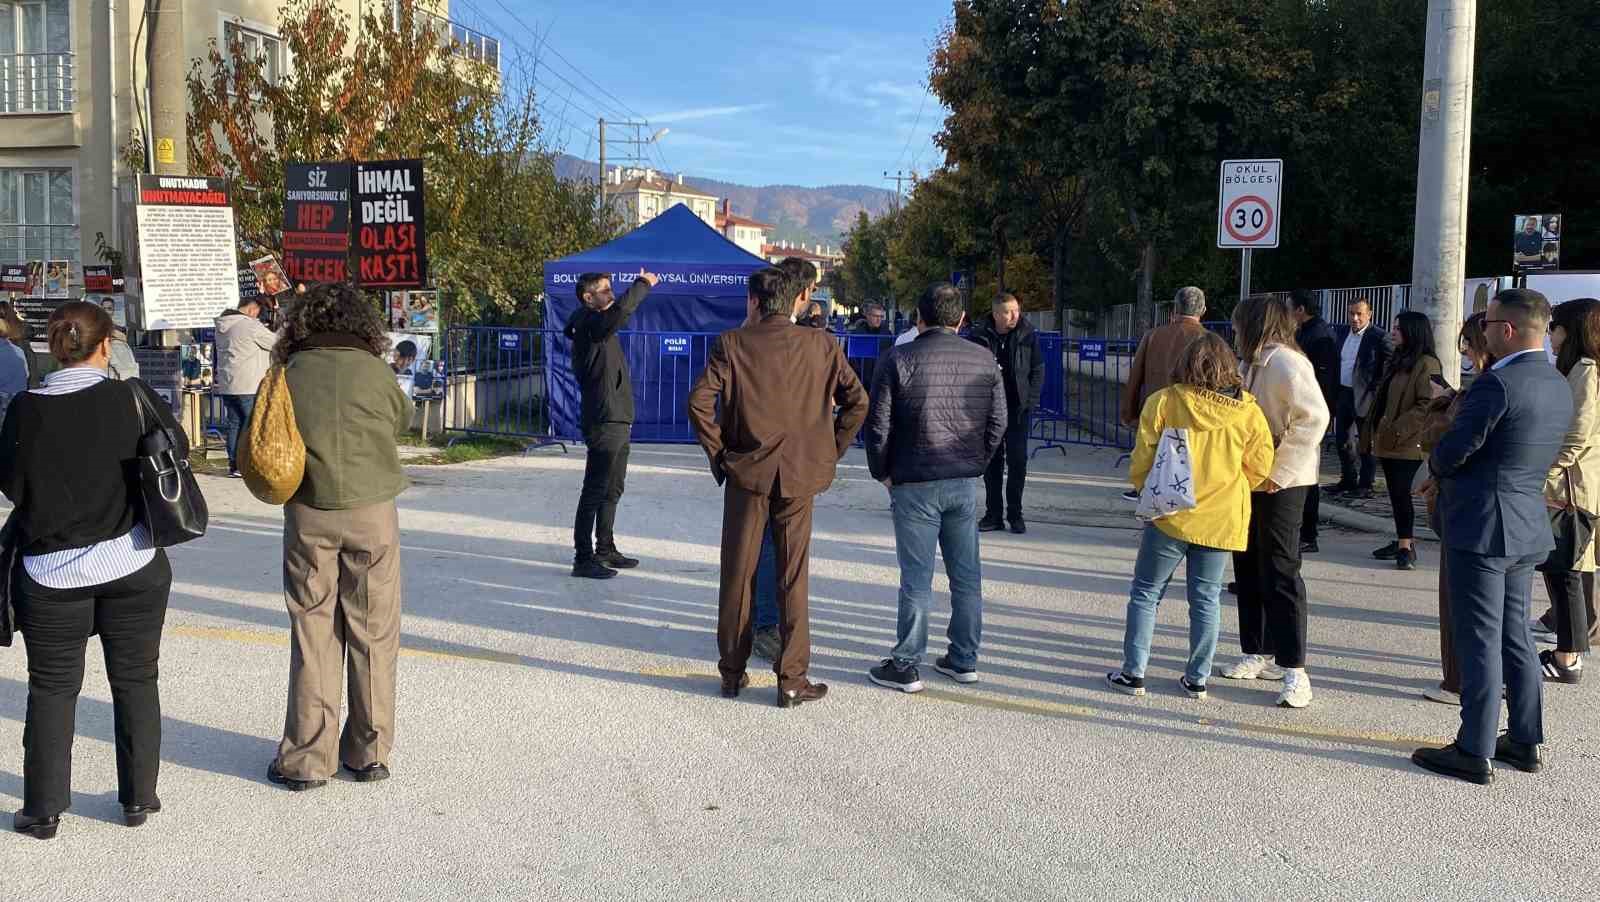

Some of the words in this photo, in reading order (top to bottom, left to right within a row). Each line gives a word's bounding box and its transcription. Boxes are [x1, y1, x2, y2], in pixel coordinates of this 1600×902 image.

[308, 166, 327, 188] SİZ
[357, 165, 415, 194] İHMAL
[1236, 165, 1267, 174] OKUL
[159, 177, 209, 190] UNUTMADIK
[287, 190, 338, 201] SANIYORSUNUZ
[339, 188, 348, 201] Kİ
[297, 204, 335, 230] HEP
[361, 194, 414, 224] DEĞİL
[1235, 208, 1263, 229] 30
[359, 252, 419, 282] KAST!
[655, 272, 688, 284] AYSAL
[689, 271, 750, 286] ÜNİVERSİTE
[664, 336, 687, 345] POLİS
